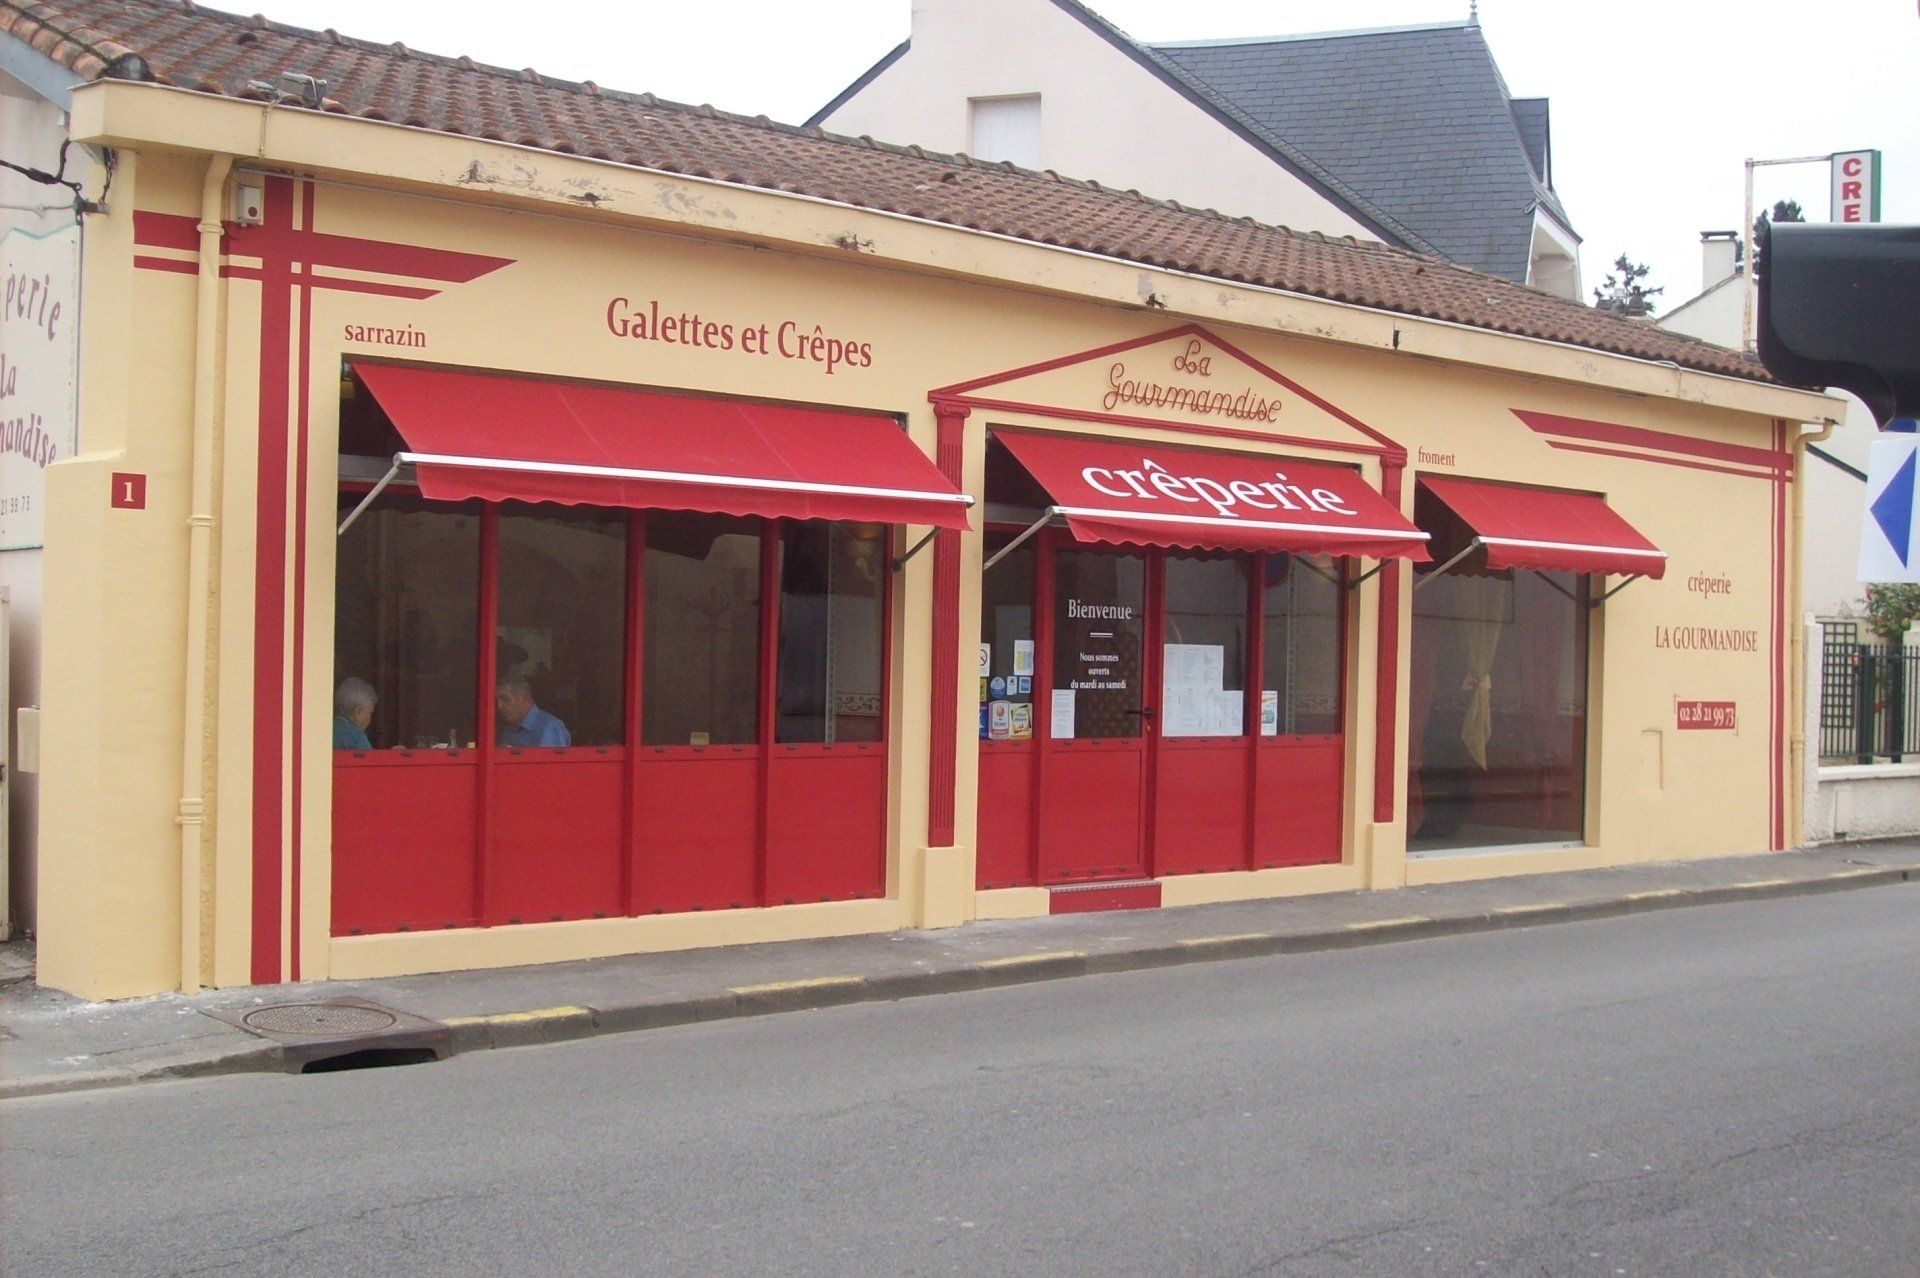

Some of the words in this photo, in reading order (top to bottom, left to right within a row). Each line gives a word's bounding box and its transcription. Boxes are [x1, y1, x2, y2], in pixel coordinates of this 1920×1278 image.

[0, 273, 60, 341] perie
[344, 323, 426, 348] sarrazin
[606, 297, 734, 350] Galettes
[741, 315, 770, 355] et
[777, 320, 873, 375] Crêpes
[1174, 339, 1212, 377] La
[1103, 362, 1283, 423] Gourmandise
[1418, 446, 1456, 467] froment
[123, 481, 135, 502] 1
[1081, 458, 1358, 518] crêperie
[1687, 571, 1731, 599] crêperie
[1068, 599, 1132, 620] Bienvenue
[1656, 626, 1670, 649] LA
[1673, 626, 1758, 652] GOURMANDISE
[1080, 652, 1094, 662] Nous
[1095, 654, 1119, 662] sommes
[1088, 667, 1110, 675] ouverts
[1070, 679, 1078, 689] du
[1080, 679, 1097, 689] mardi
[1098, 681, 1105, 689] au
[1106, 679, 1127, 689] samedi
[1679, 707, 1690, 721] 02
[1692, 702, 1702, 721] 28
[1703, 707, 1712, 721] 21
[1713, 707, 1724, 727] 99
[1725, 707, 1735, 727] 73
